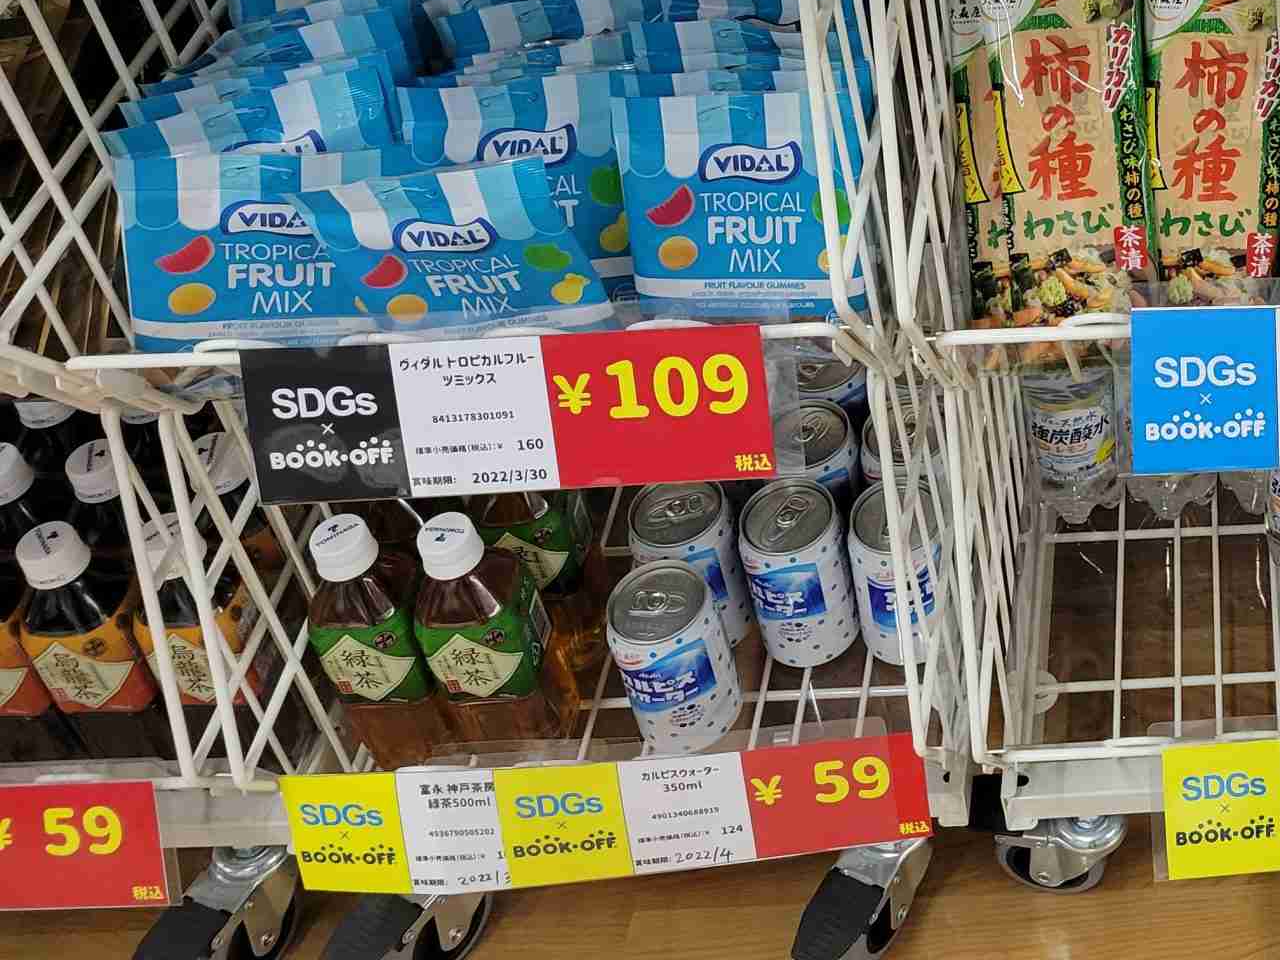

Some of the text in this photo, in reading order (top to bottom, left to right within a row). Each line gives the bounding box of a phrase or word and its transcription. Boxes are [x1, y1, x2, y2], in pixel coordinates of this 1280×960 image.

[1021, 36, 1098, 202] 柿の種
[1176, 40, 1249, 202] 柿の種
[493, 133, 564, 157] VIDAL
[714, 153, 789, 174] VIDAL
[701, 192, 807, 214] TROPICAL
[707, 216, 802, 245] FRUIT
[1024, 204, 1114, 239] わさび
[1160, 208, 1252, 238] わさび
[406, 228, 486, 248] VIDAL
[411, 253, 520, 274] TROPICAL
[729, 249, 782, 273] MIX
[227, 262, 336, 289] FRUIT
[425, 269, 522, 297] FRUIT
[251, 291, 313, 315] MIX
[460, 296, 517, 321] MIX
[442, 373, 497, 387] ツミックス
[1154, 354, 1257, 388] SDGs
[271, 386, 378, 419] SDGs
[517, 437, 544, 452] 160
[735, 453, 773, 472] 税込
[472, 468, 548, 485] 2022/3/30
[1182, 772, 1267, 801] SDGs
[300, 803, 384, 827] SDGs
[515, 792, 604, 818] SDGs
[43, 805, 123, 857] 59
[721, 823, 743, 835] 124
